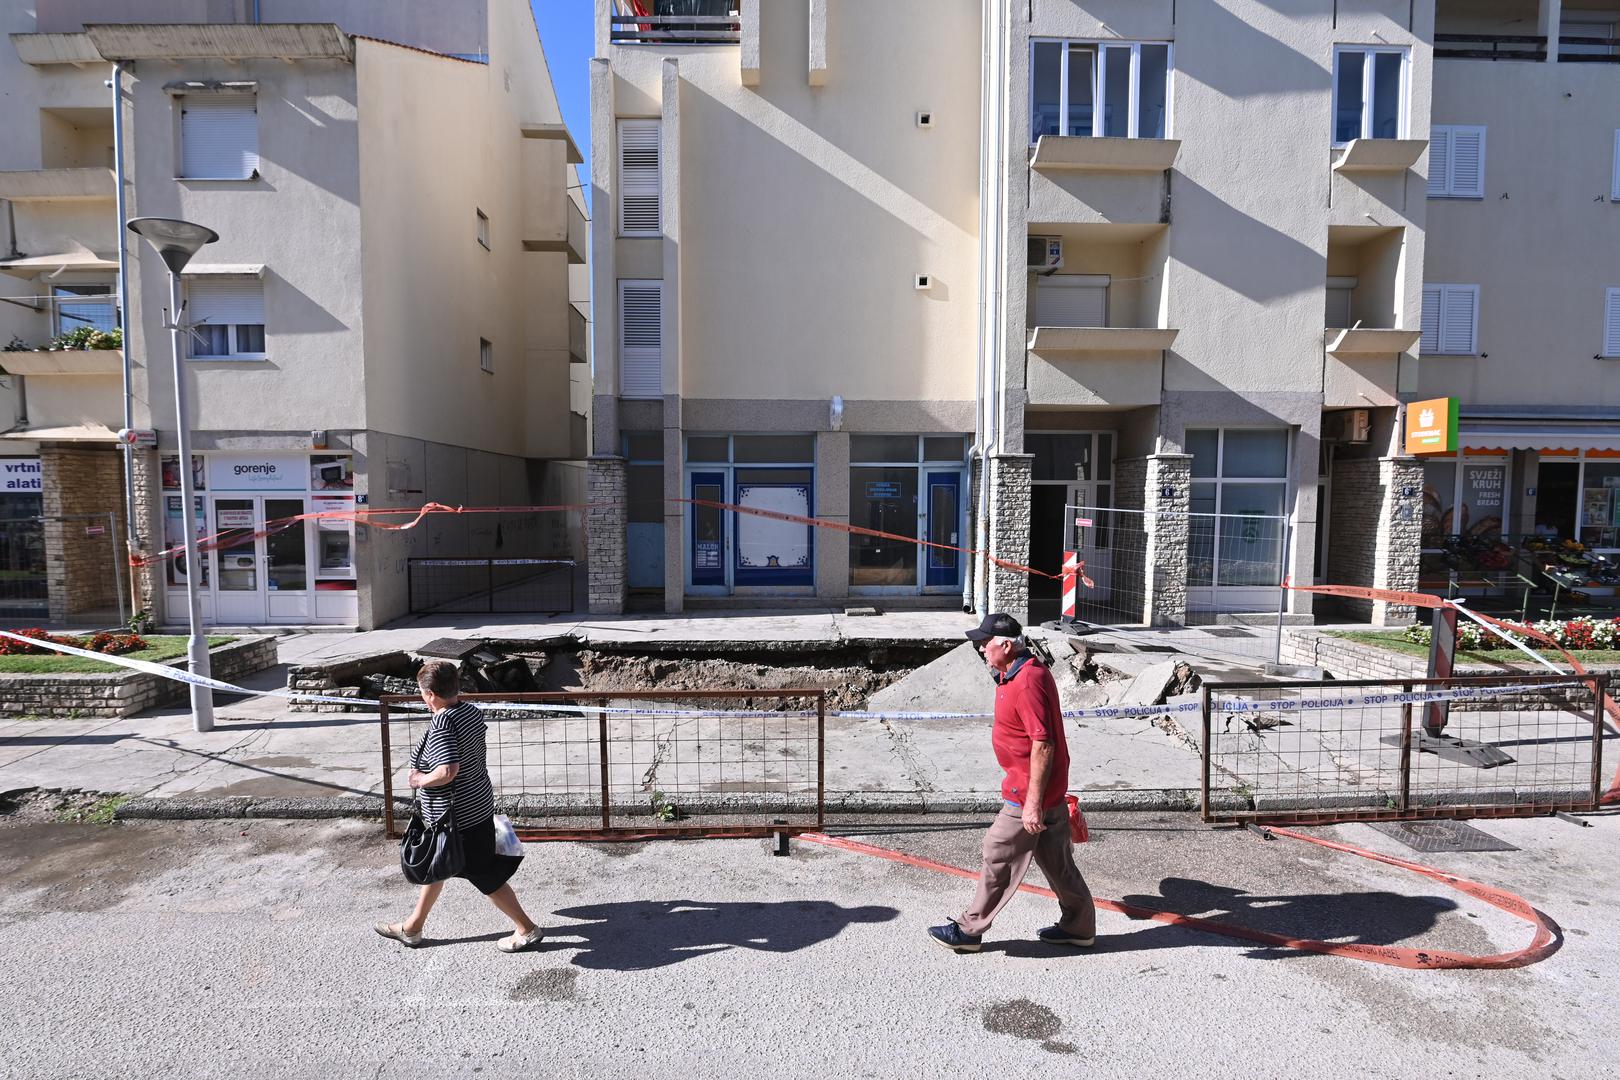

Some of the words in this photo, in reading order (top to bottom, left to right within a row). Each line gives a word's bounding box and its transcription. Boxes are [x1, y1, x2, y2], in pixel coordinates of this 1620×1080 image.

[5, 462, 40, 472] vrtni
[233, 462, 276, 475] gorenje
[1470, 469, 1502, 479] SVJEŽI
[7, 478, 41, 488] alati
[1472, 480, 1500, 488] KRUH
[1364, 695, 1387, 704] STOP
[1393, 692, 1434, 702] POLICIJA
[1178, 703, 1199, 711] STOP
[1210, 701, 1248, 710] OLICIJA
[1270, 701, 1295, 709] STOP
[1301, 699, 1344, 708] POLICIJA
[1095, 708, 1119, 717] STOP
[1124, 707, 1162, 716] POLICIJA
[1378, 947, 1401, 959] KABEL
